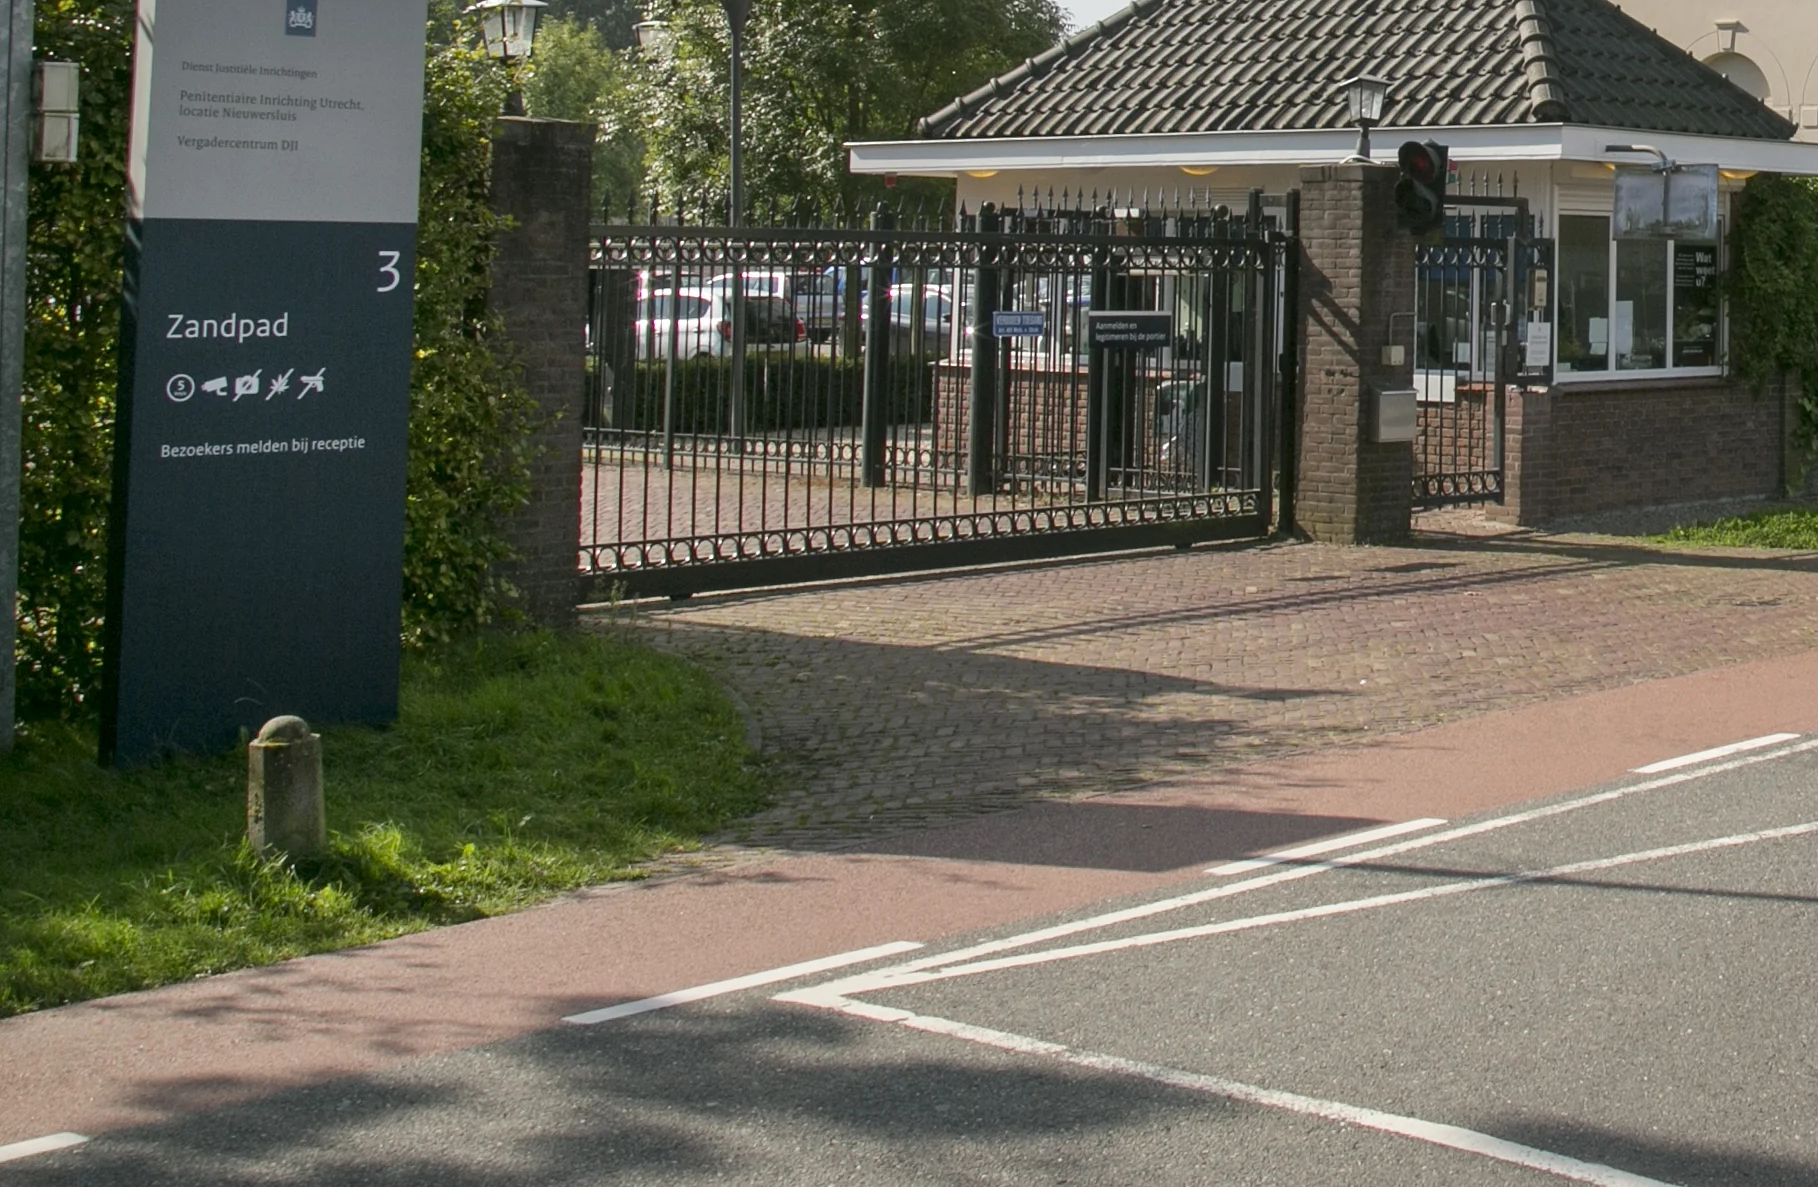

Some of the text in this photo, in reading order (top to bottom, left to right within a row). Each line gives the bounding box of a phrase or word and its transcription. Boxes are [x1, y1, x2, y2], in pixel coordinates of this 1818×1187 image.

[182, 61, 318, 80] Dienst Justitiële Inrichtingen
[180, 90, 365, 111] Penitentiaire Inrichting Utrecht,
[179, 104, 297, 122] locatie Nieuwersluis
[177, 136, 299, 151] Vergadercentrum DJI
[1695, 251, 1712, 263] Wat
[376, 250, 401, 293] 3
[166, 312, 289, 344] Zandpad
[1095, 322, 1128, 330] Aanmelden
[1129, 333, 1137, 342] bij
[1138, 333, 1145, 341] de
[1146, 333, 1166, 342] portier
[177, 379, 186, 391] 5
[160, 435, 366, 457] Bezoekers melden bij receptie
